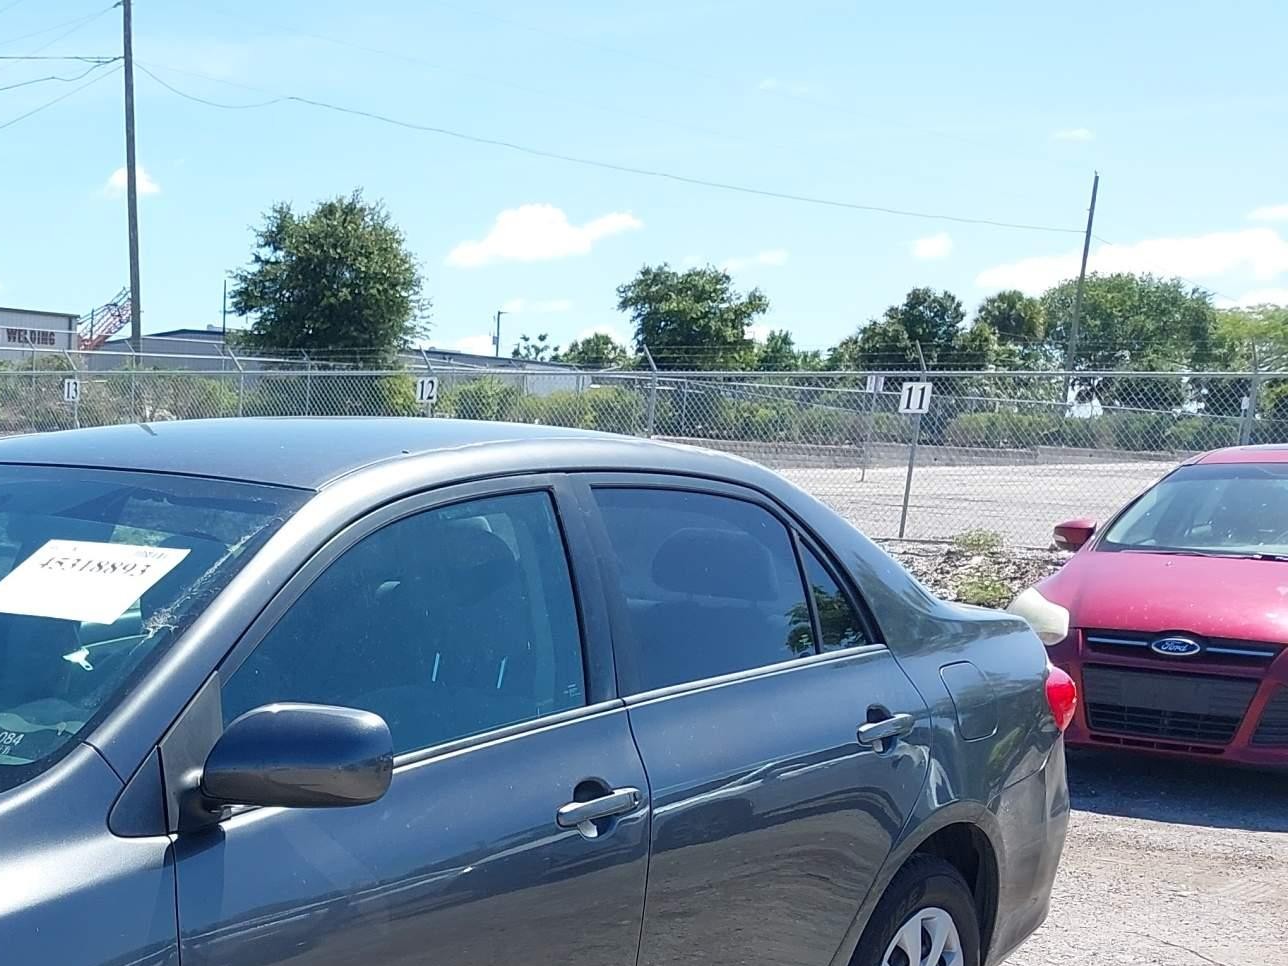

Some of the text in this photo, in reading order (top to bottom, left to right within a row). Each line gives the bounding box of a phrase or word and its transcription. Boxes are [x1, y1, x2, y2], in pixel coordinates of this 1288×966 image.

[66, 381, 78, 400] 13
[418, 380, 435, 400] 12
[903, 385, 926, 410] 11
[39, 556, 152, 577] 45318893
[1161, 641, 1189, 652] Ford
